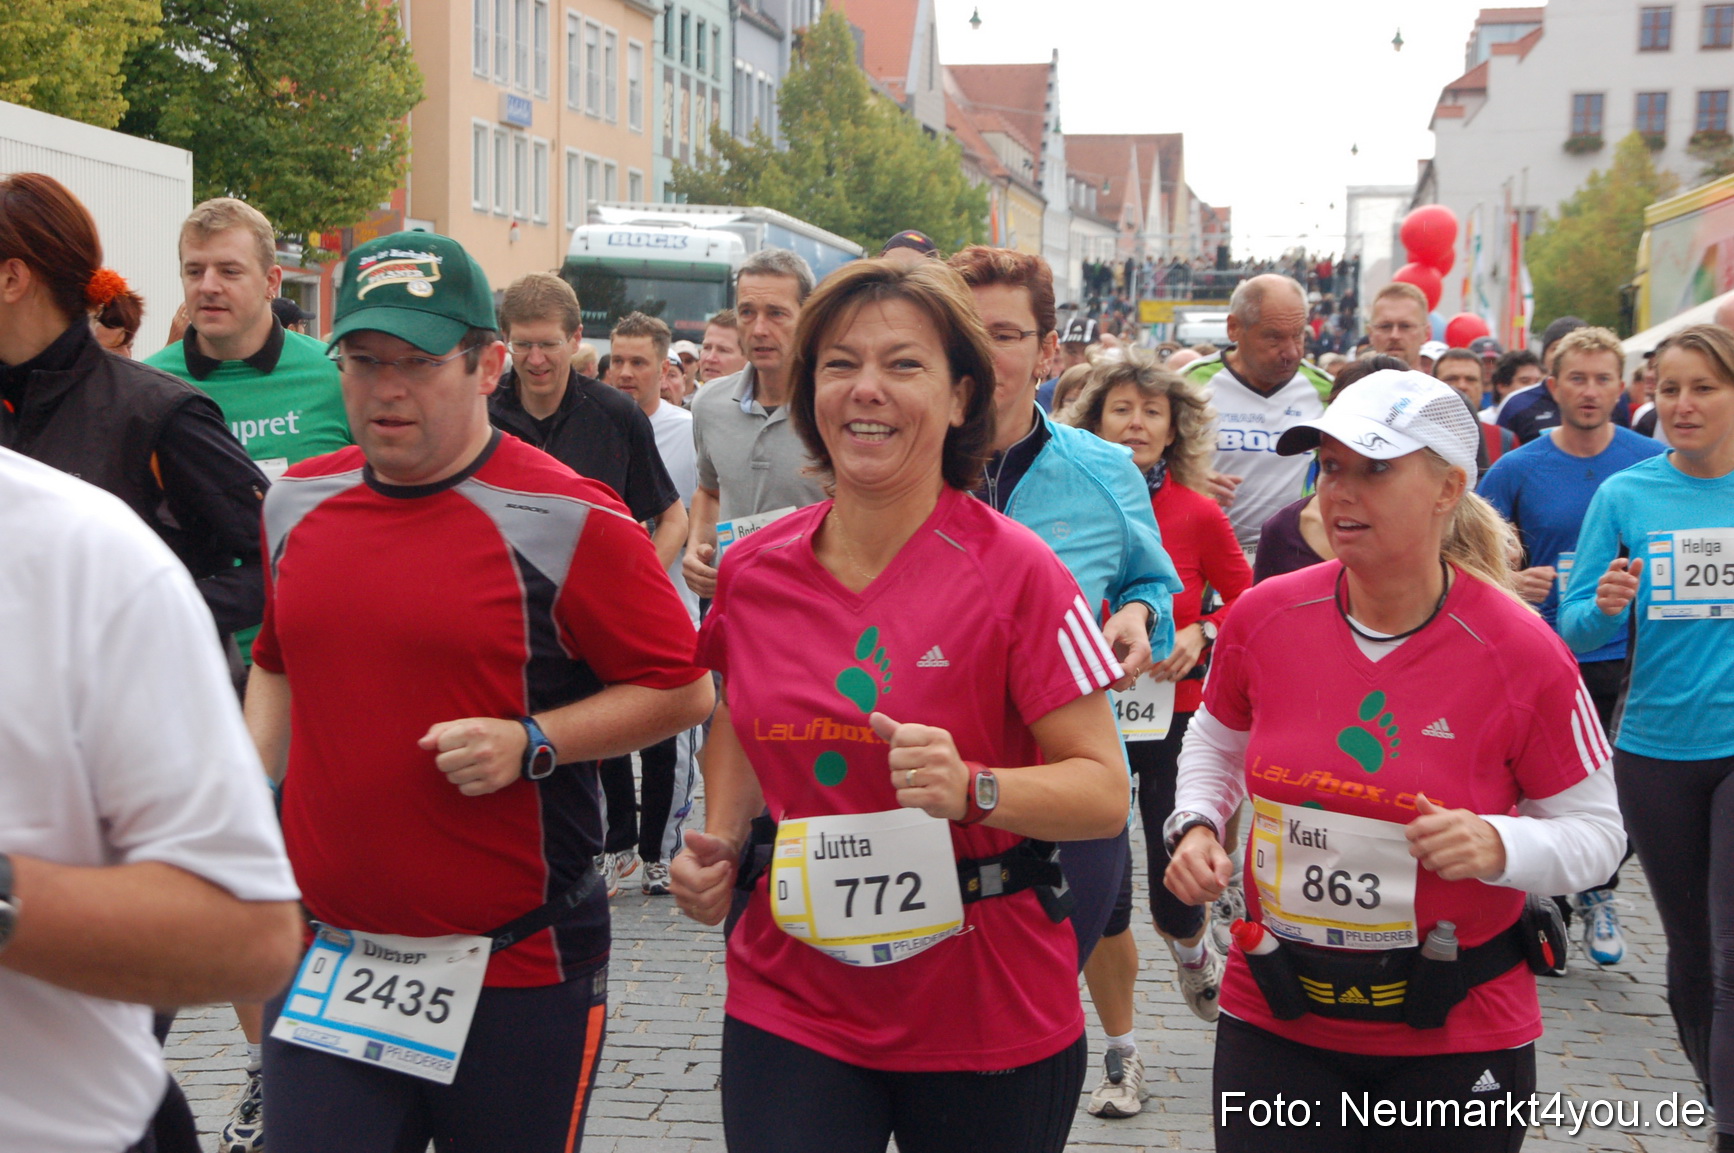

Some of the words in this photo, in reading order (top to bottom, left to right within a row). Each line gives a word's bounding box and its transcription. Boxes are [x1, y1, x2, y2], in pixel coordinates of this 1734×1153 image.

[607, 231, 688, 250] BOCK
[1682, 538, 1722, 556] Helga
[1685, 563, 1734, 587] 205
[916, 660, 950, 668] adidas
[754, 717, 890, 744] Laufbox.
[1421, 728, 1456, 740] adidas
[1251, 756, 1445, 811] Laufbox.
[1289, 818, 1328, 851] Kati
[815, 832, 872, 860] Jutta
[778, 880, 788, 901] D
[835, 871, 926, 918] 772
[1302, 864, 1382, 910] 863
[1345, 930, 1414, 943] PFLEIDERER
[344, 968, 456, 1024] 2435
[1338, 997, 1370, 1005] adidas
[1471, 1082, 1501, 1092] adidas
